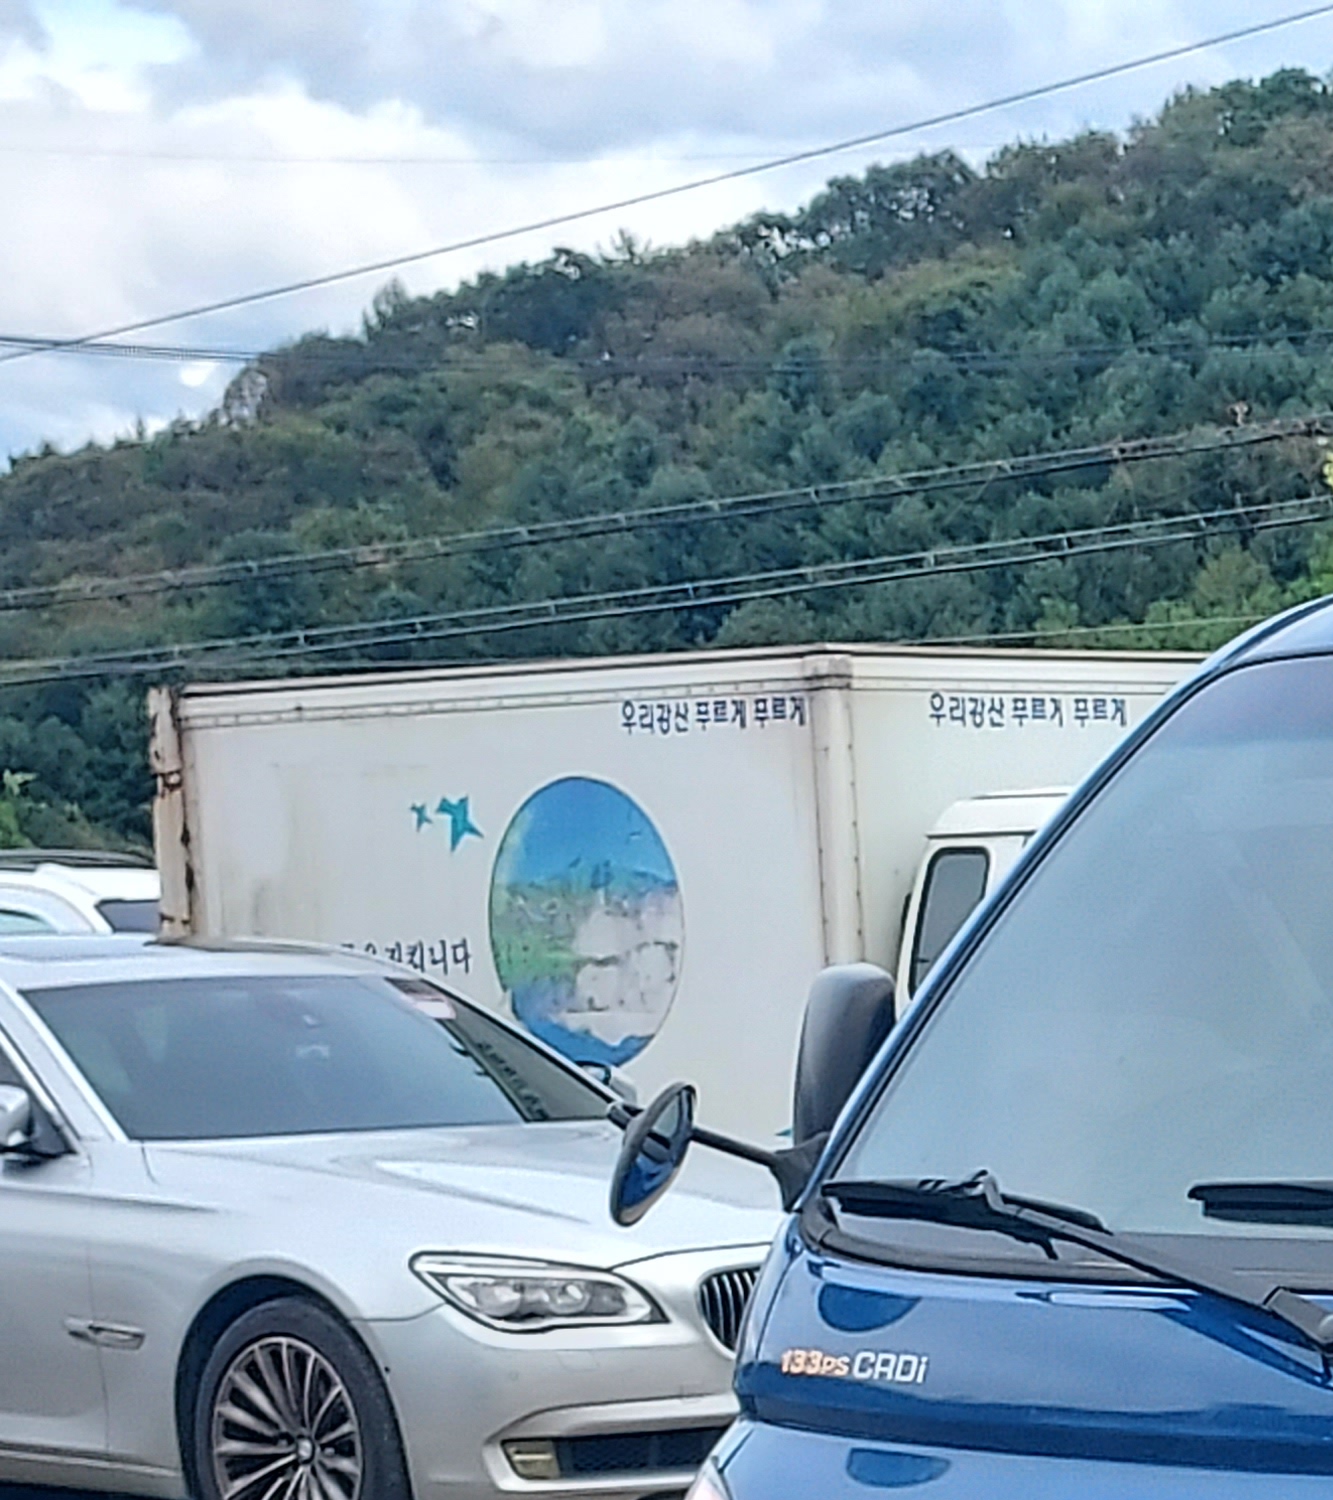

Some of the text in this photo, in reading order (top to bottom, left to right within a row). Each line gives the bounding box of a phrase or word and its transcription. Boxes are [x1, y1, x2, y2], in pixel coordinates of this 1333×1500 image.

[621, 696, 806, 736] 우리강산 푸르게 푸르게
[928, 691, 1006, 729] 우리강산
[1073, 696, 1128, 729] 푸르게
